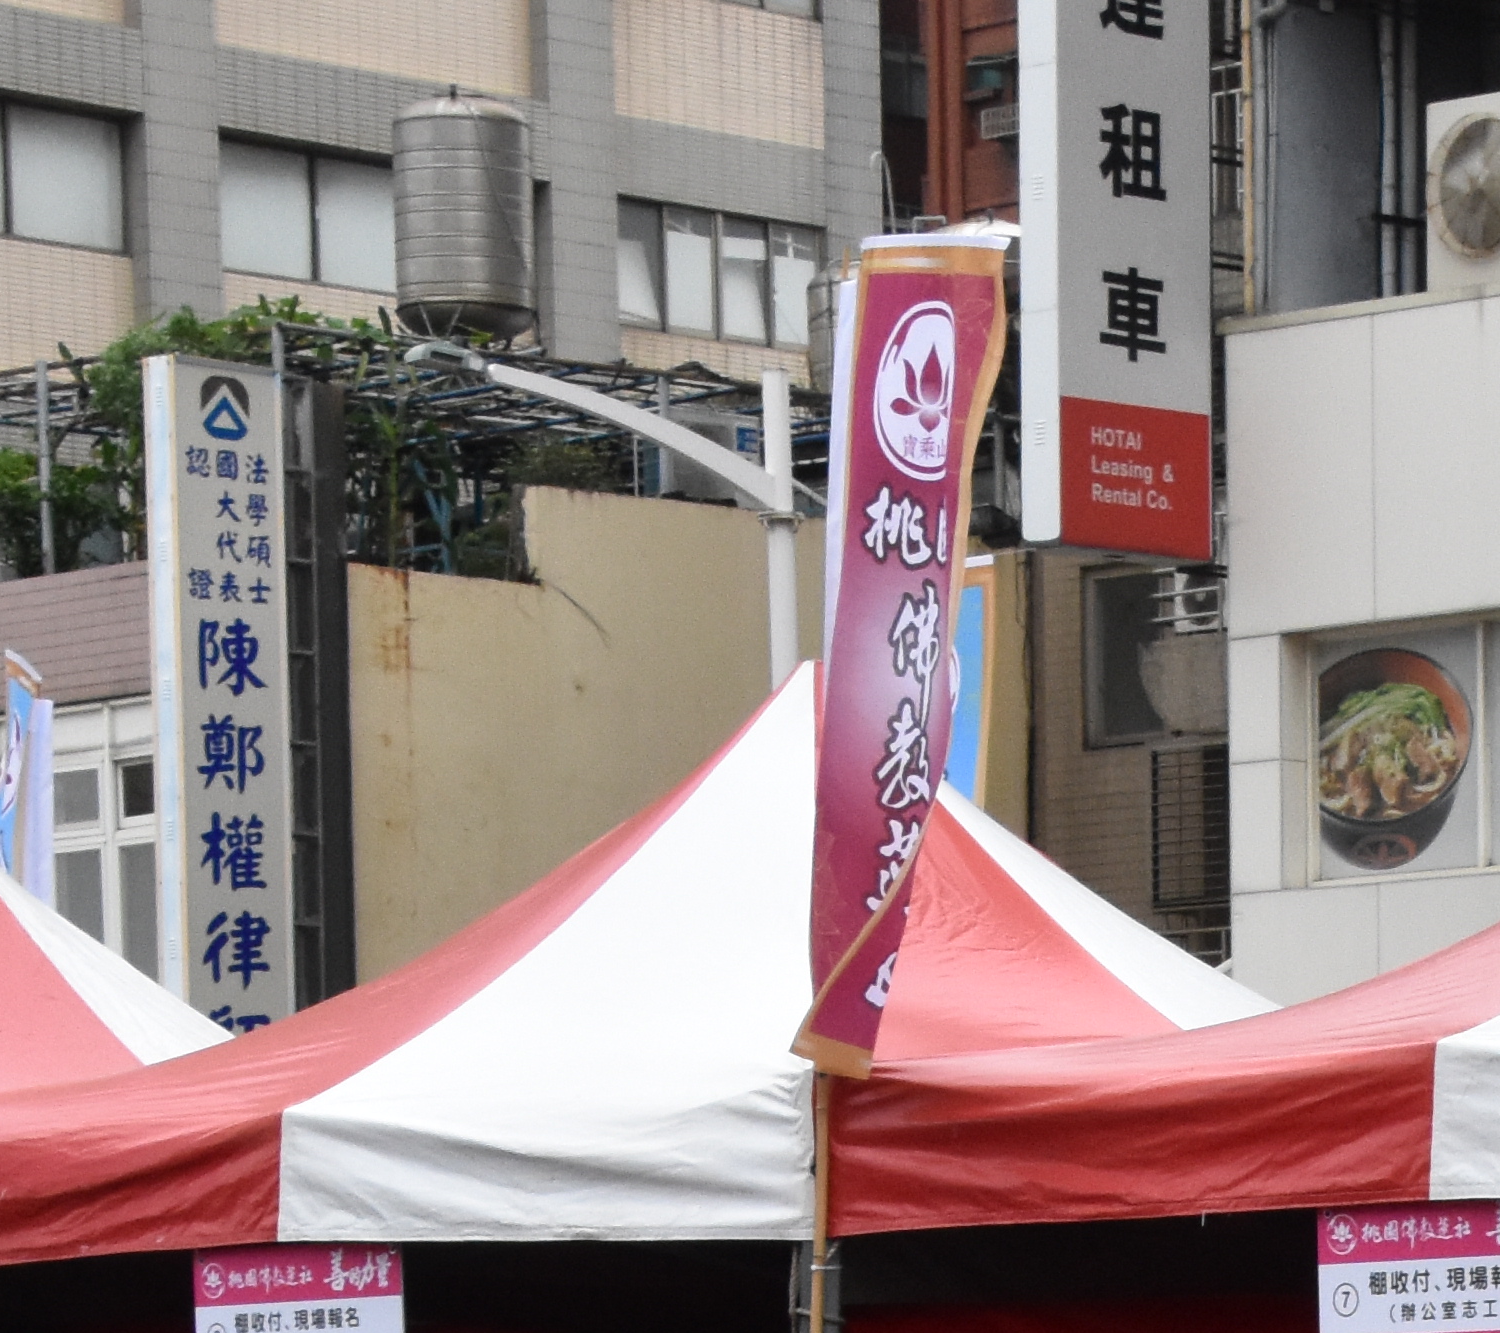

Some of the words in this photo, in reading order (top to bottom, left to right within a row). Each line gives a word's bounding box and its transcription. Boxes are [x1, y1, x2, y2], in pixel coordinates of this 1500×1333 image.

[1091, 426, 1142, 450] HOTAI
[1091, 455, 1153, 484] Leasing
[1162, 464, 1174, 483] &
[1091, 483, 1142, 507] Rental
[1147, 490, 1173, 510] Co.
[185, 445, 214, 600] 認證
[216, 450, 242, 603] 國大代表
[246, 453, 271, 604] 法學碩士
[197, 619, 271, 1034] 陳鄭權律
